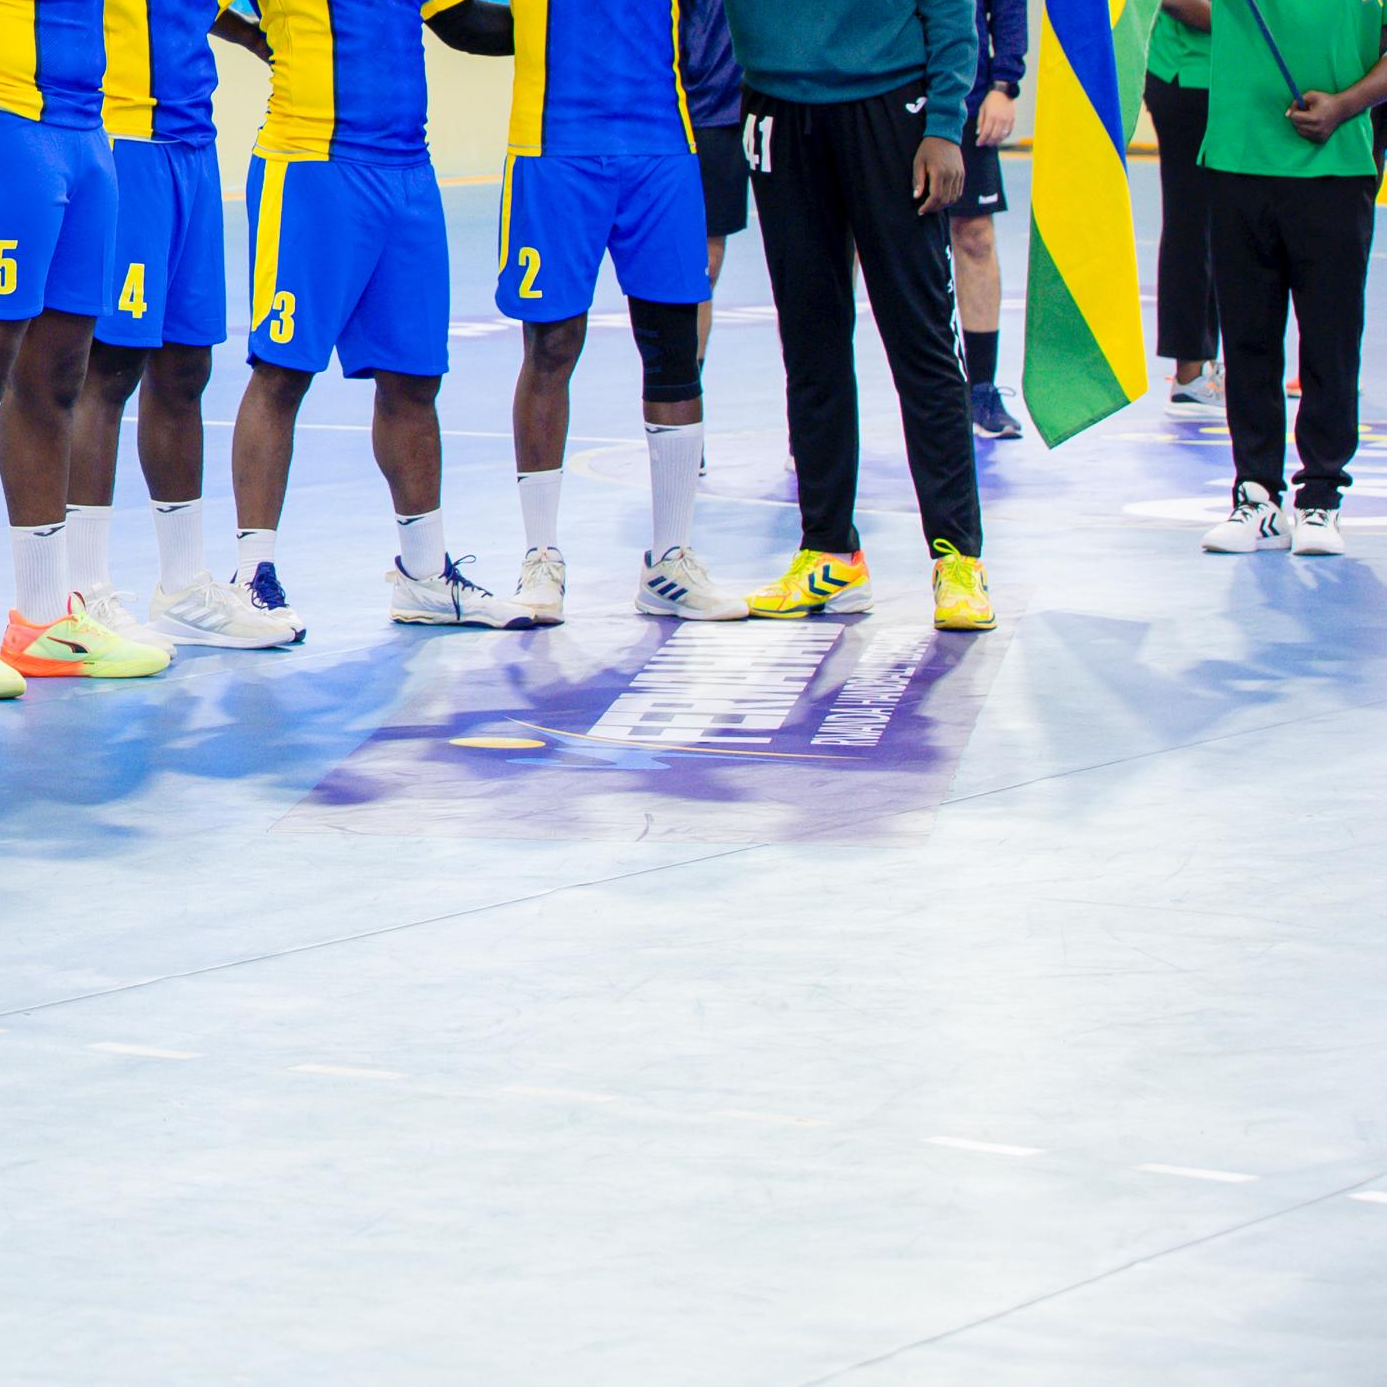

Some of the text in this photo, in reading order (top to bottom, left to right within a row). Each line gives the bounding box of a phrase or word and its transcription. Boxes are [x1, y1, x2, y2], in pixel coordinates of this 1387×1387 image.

[743, 113, 773, 173] 41
[118, 262, 148, 319] 4
[518, 246, 543, 299] 2
[270, 291, 296, 344] 3
